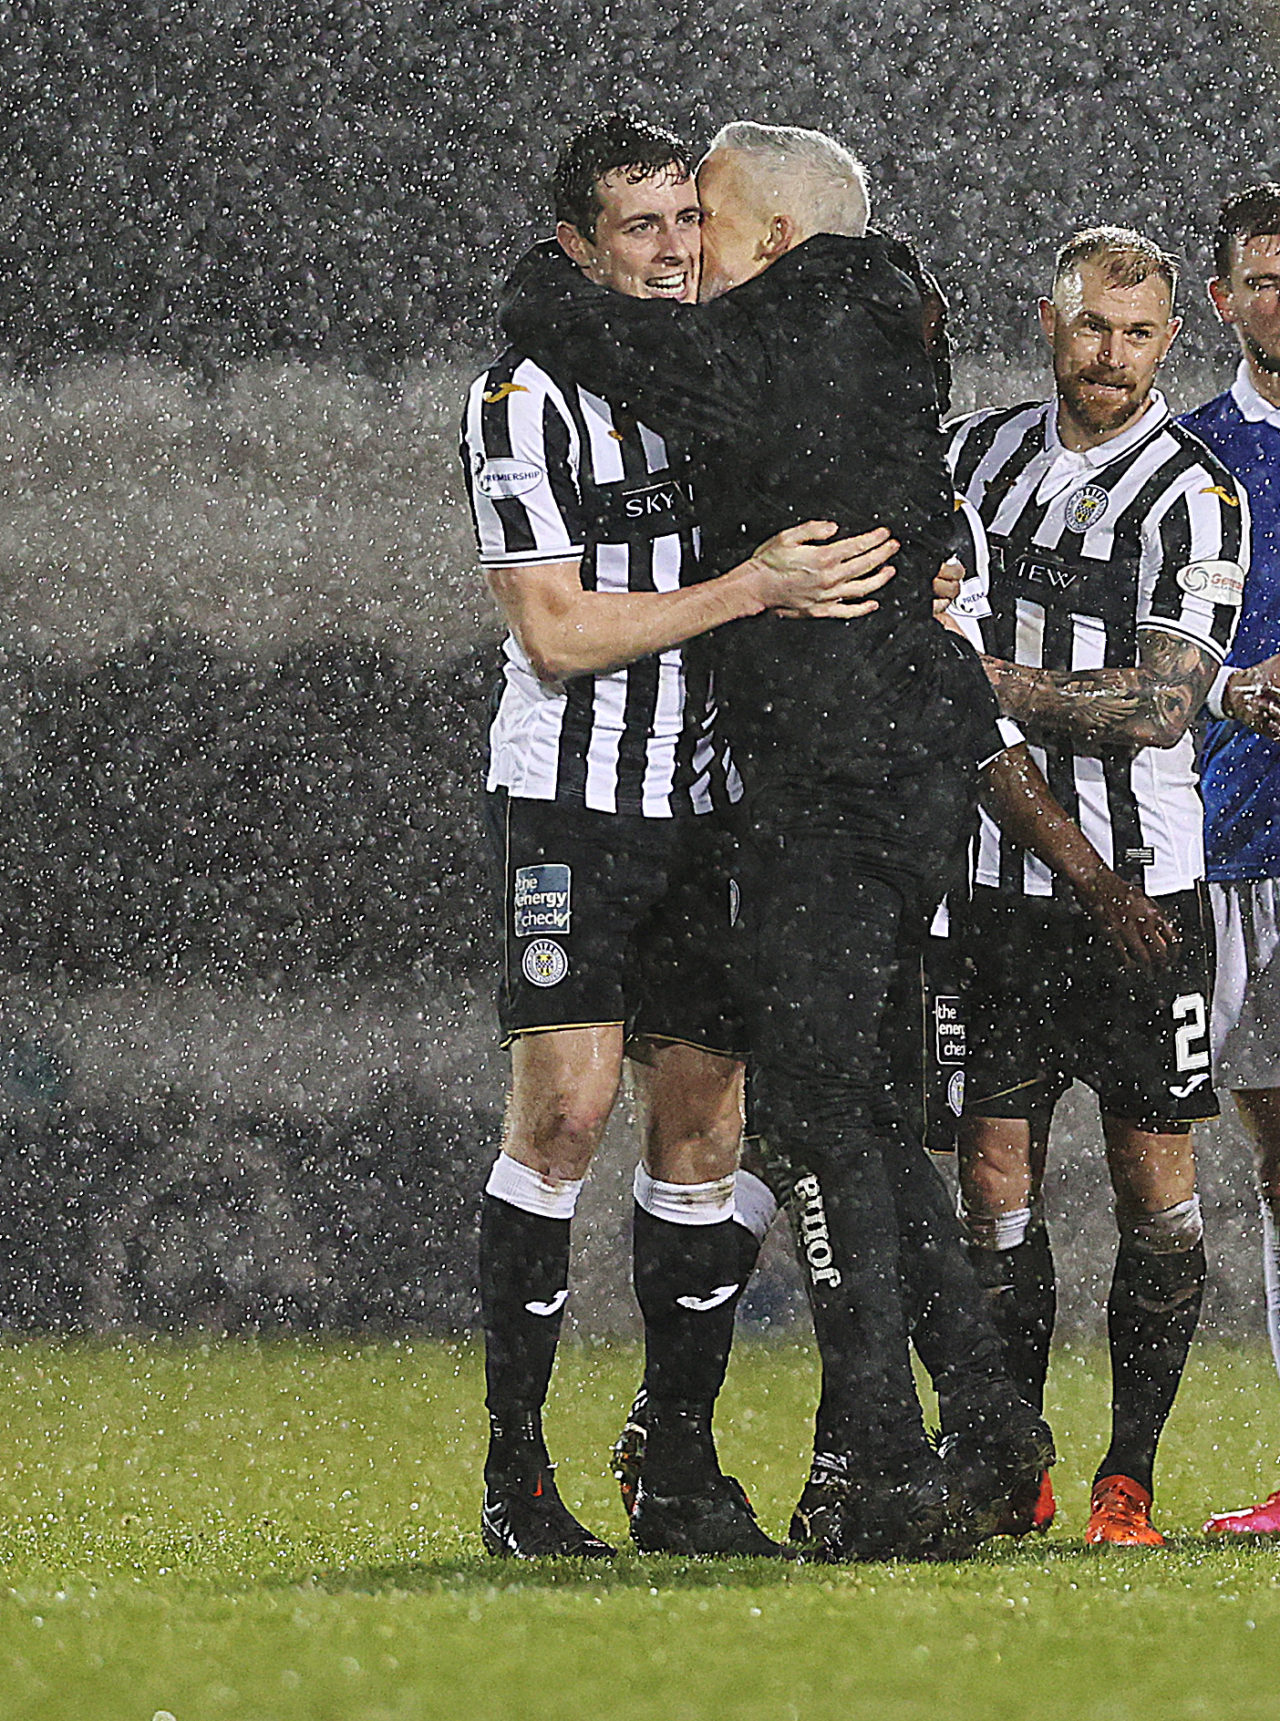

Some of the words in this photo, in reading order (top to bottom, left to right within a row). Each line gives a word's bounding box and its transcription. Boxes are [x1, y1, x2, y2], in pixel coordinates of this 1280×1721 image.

[516, 892, 567, 908] energy
[938, 1003, 957, 1019] the
[1173, 992, 1210, 1072] 2
